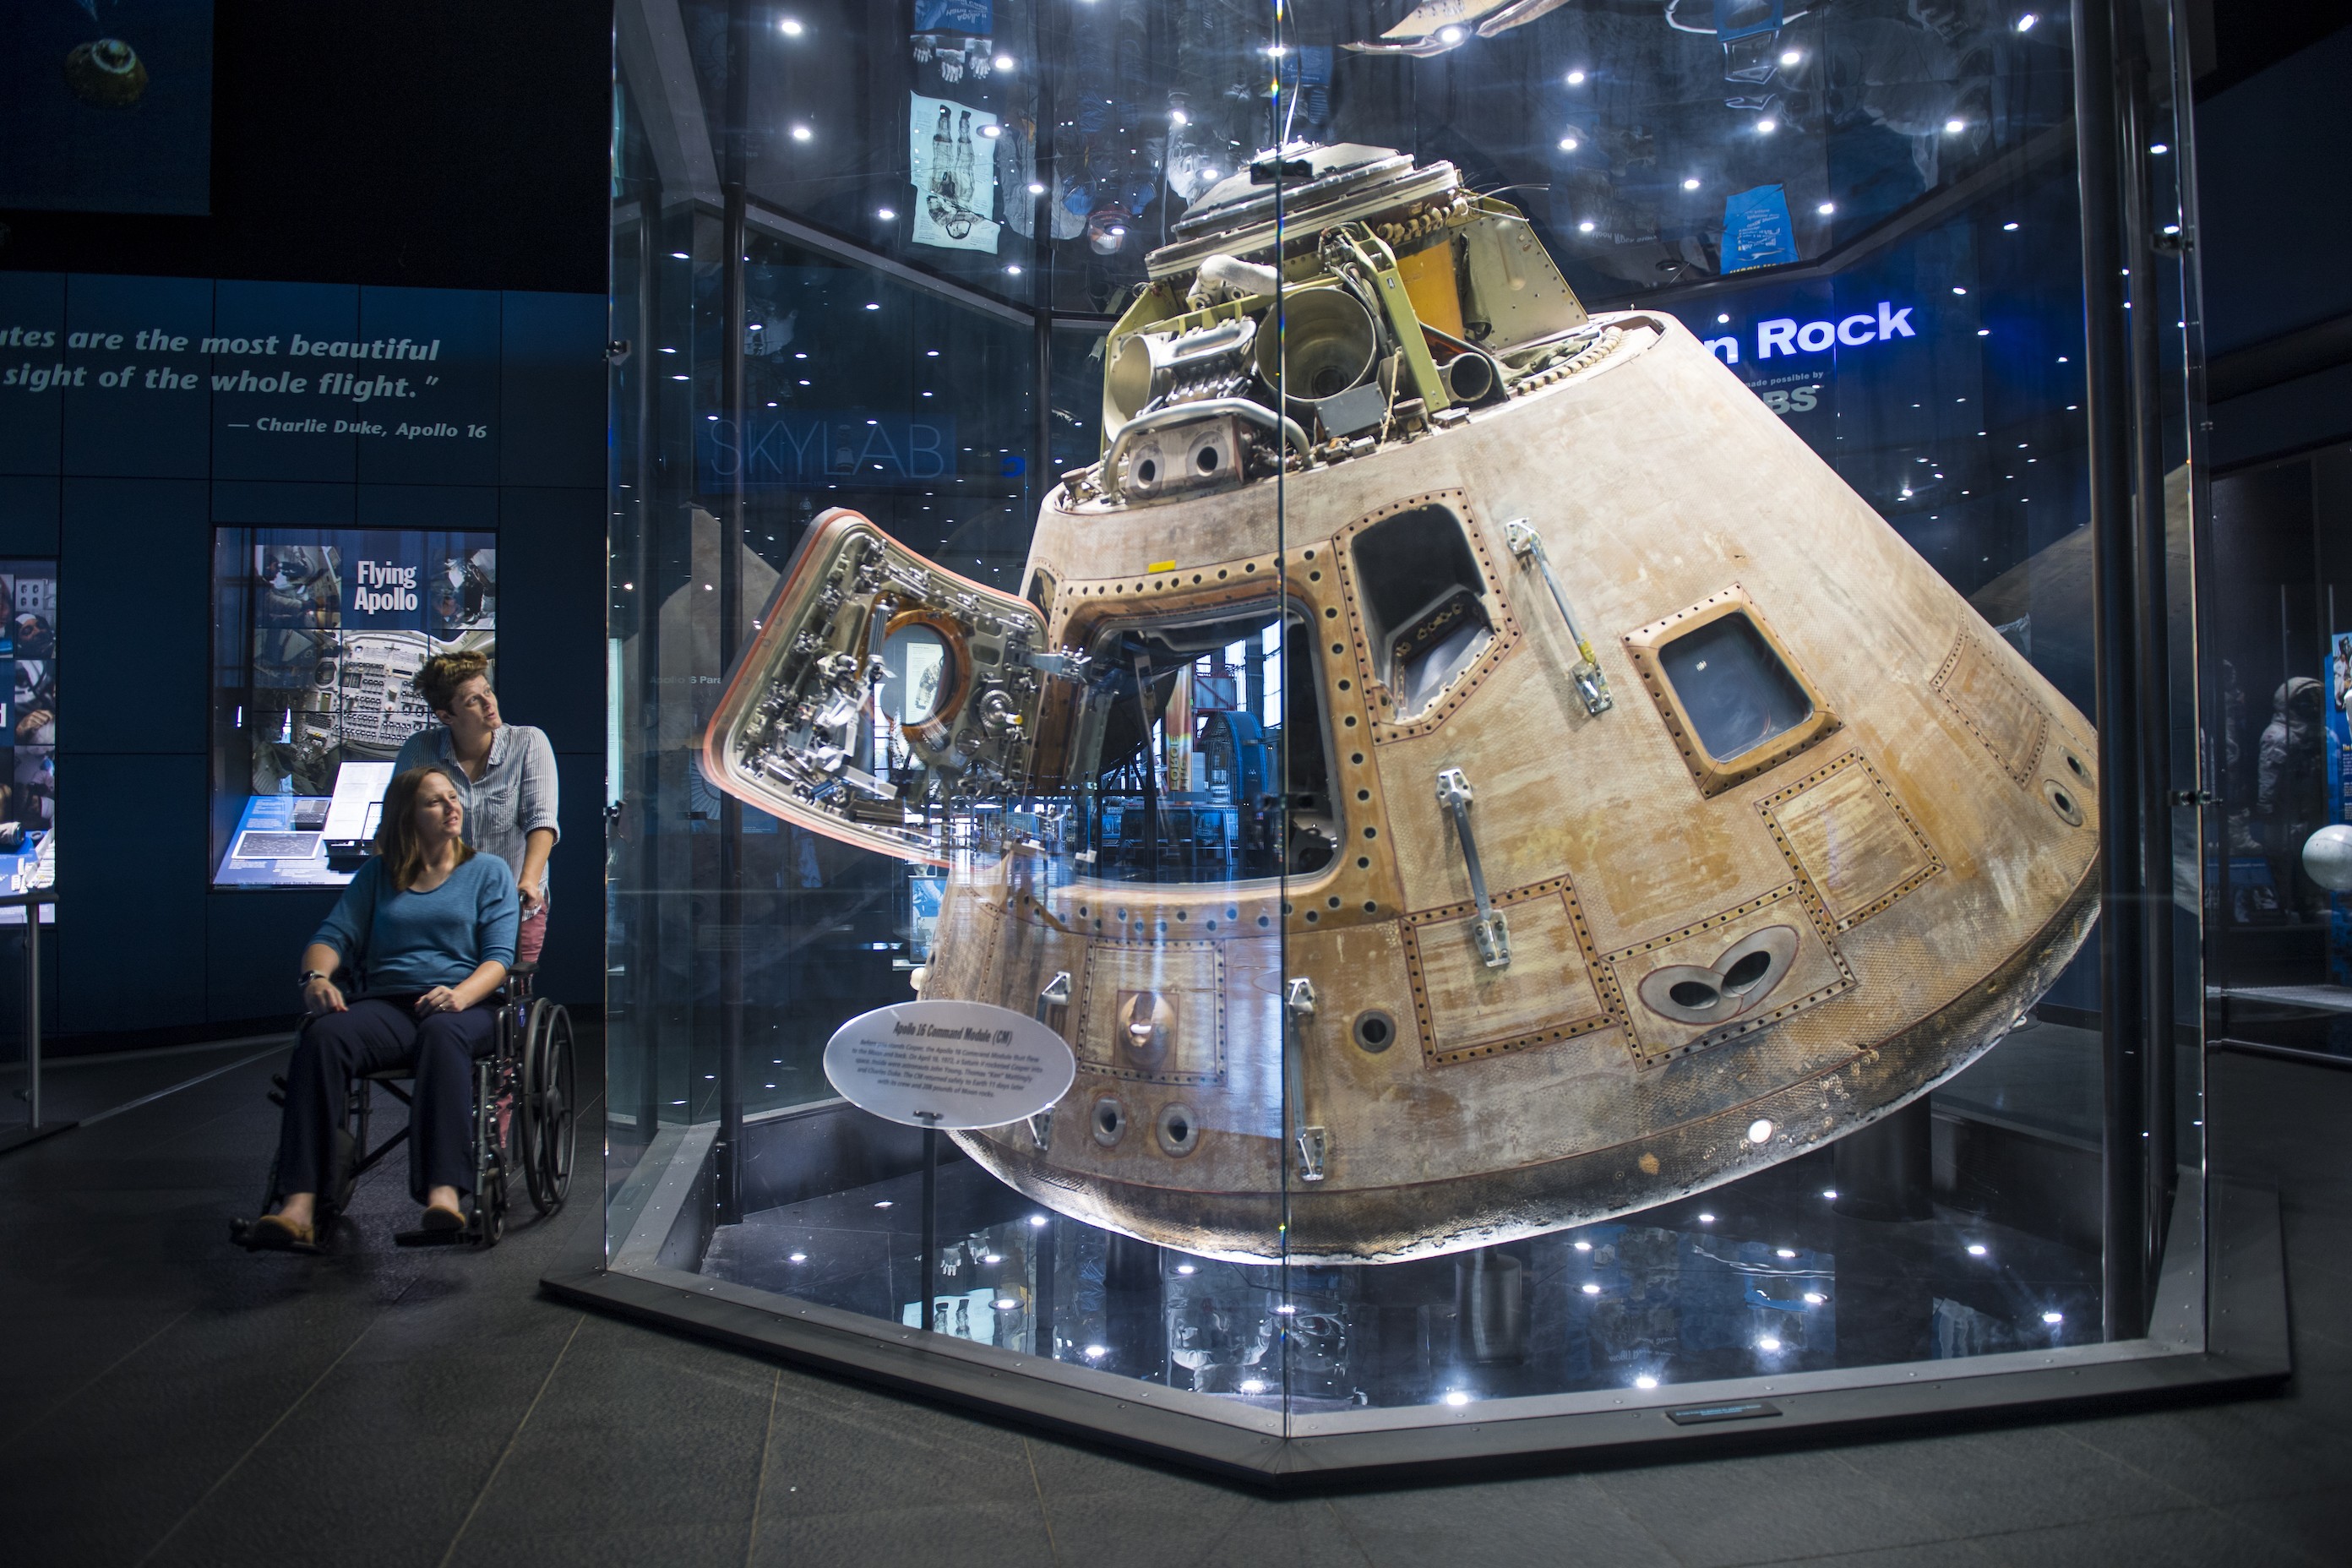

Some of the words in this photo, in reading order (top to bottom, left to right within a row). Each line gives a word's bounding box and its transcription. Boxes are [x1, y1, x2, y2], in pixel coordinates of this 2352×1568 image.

[68, 332, 124, 350] are
[136, 329, 188, 351] the
[200, 336, 279, 354] most
[290, 335, 440, 360] beautiful
[1758, 302, 1916, 359] Rock
[3, 362, 88, 393] sight
[99, 366, 136, 387] of
[145, 368, 198, 389] the
[212, 370, 307, 393] whole
[1771, 373, 1810, 385] possible
[257, 418, 327, 432] Charlie
[334, 420, 387, 437] Duke,
[395, 423, 458, 439] Apollo
[468, 425, 487, 438] 16
[710, 419, 945, 479] SKYLAB
[357, 561, 416, 591] Flying
[354, 586, 417, 614] Apollo
[893, 1021, 916, 1037] Apollo
[917, 1024, 927, 1037] 16
[927, 1024, 964, 1039] Command
[964, 1027, 990, 1043] Module
[993, 1030, 1013, 1047] (CM)
[1005, 1074, 1033, 1083] Mattingly
[1011, 1064, 1030, 1072] Casper
